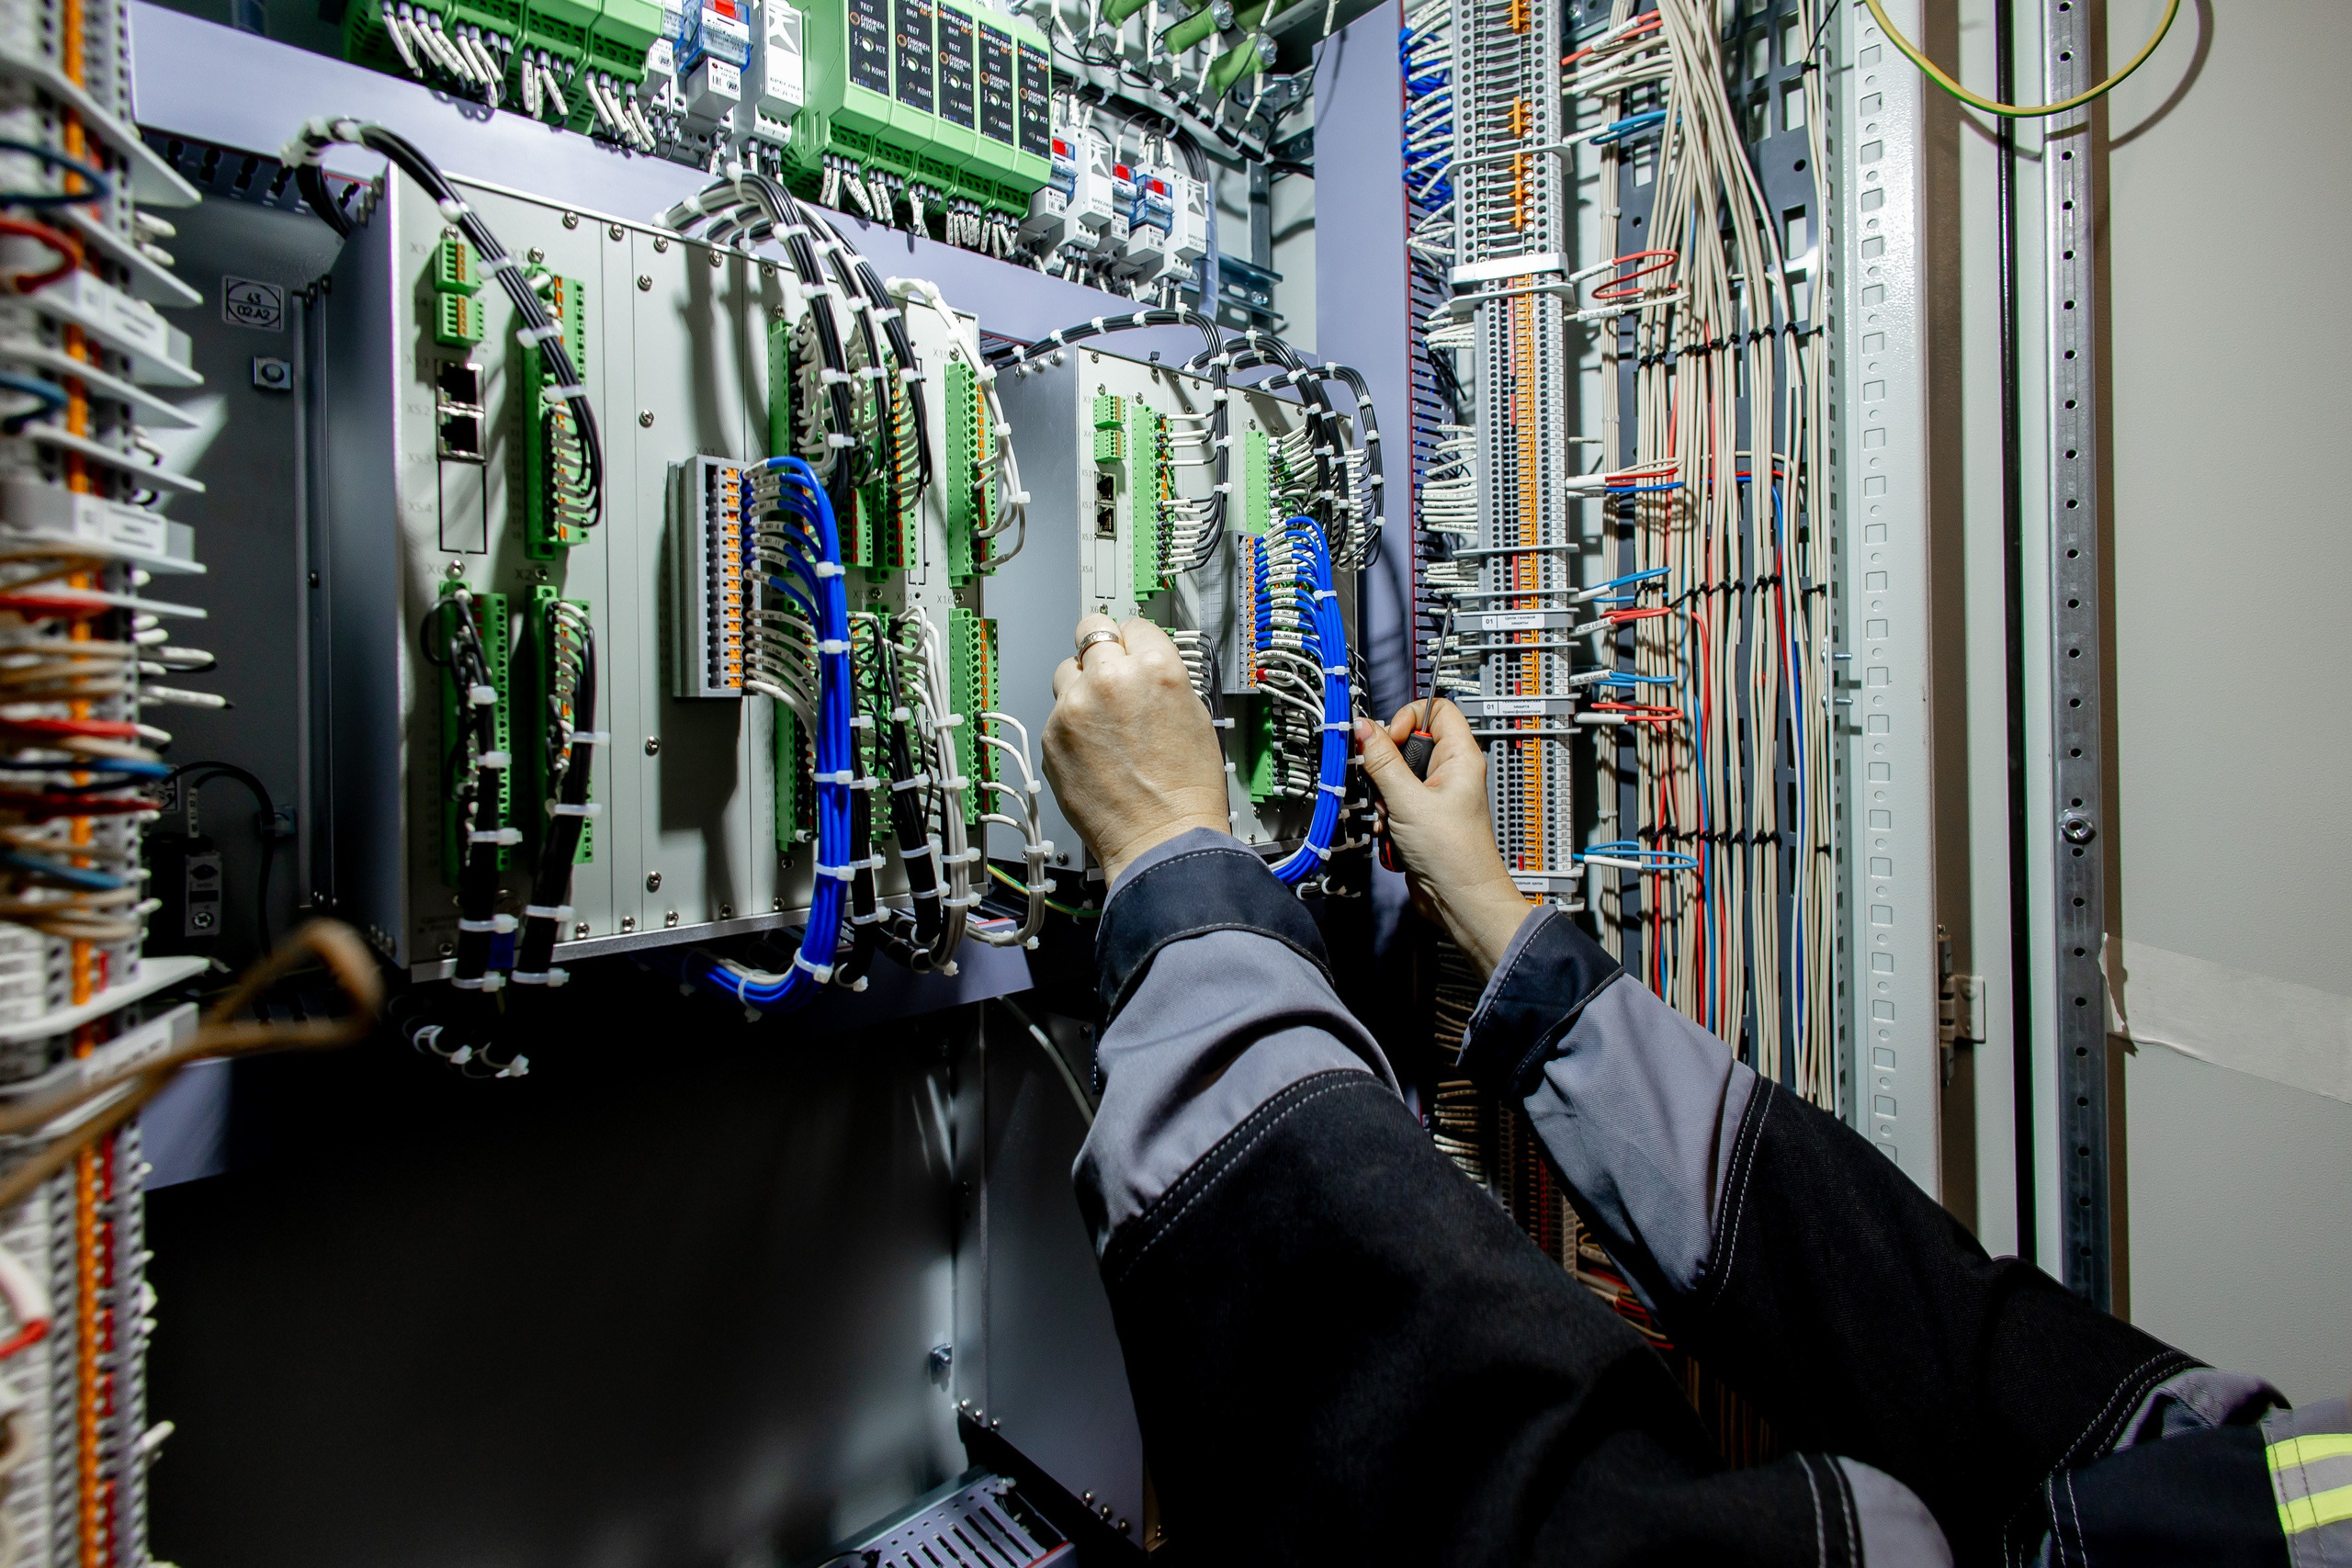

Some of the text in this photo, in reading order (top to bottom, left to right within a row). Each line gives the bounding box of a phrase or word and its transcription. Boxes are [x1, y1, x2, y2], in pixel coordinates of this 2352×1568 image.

[860, 1, 873, 13] ТЕСТ
[906, 7, 918, 19] ВКЛ
[943, 12, 973, 29] БРЕСЛЕР
[907, 24, 919, 36] ТЕСТ
[948, 26, 958, 37] ВКЛ
[983, 32, 1012, 50] БРЕСЛЕР
[948, 41, 960, 53] ТЕСТ
[988, 47, 999, 57] ВКЛ
[1022, 49, 1049, 66] БРЕСЛЕР
[989, 62, 1001, 73] ТЕСТ
[1027, 78, 1038, 88] ТЕСТ
[1126, 395, 1134, 403] X1
[896, 592, 914, 603] X14
[937, 595, 954, 605] X16
[1091, 605, 1099, 614] X6
[1128, 607, 1137, 615] X2
